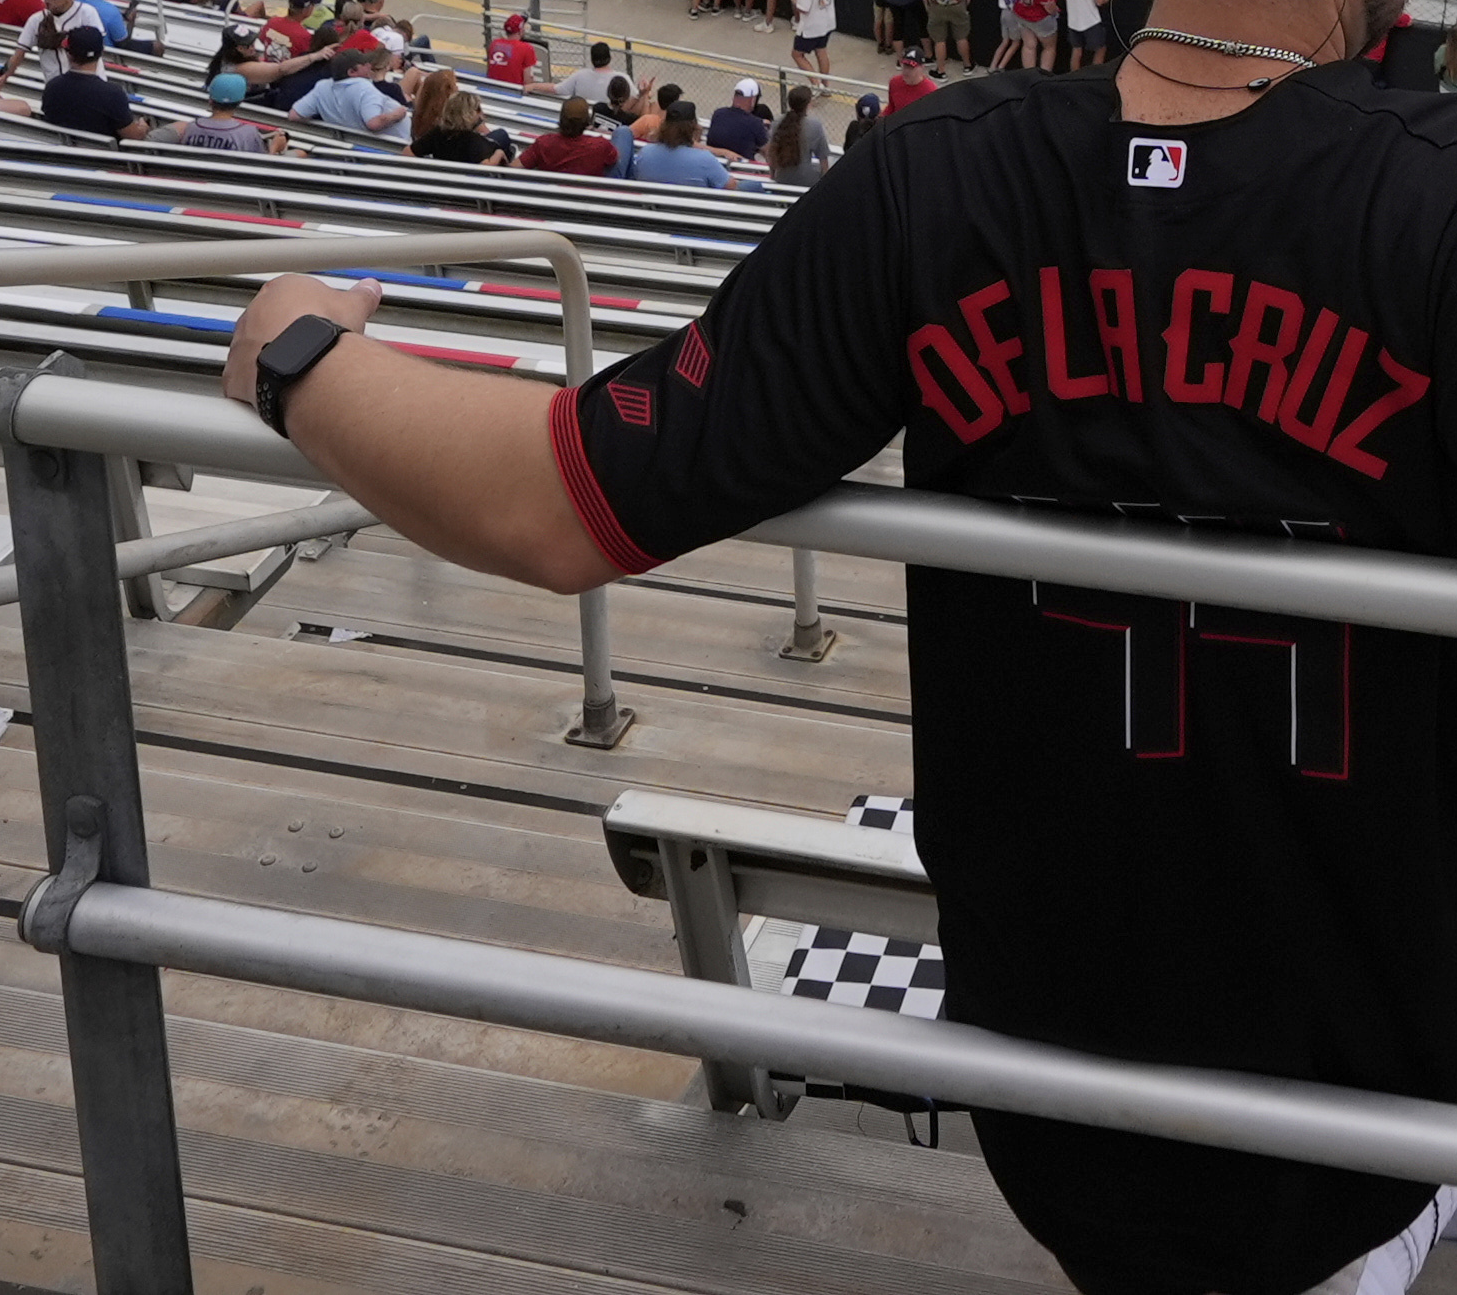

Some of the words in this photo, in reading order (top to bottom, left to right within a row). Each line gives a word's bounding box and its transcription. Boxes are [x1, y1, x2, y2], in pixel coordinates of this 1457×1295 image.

[907, 280, 1030, 444] DE
[1039, 266, 1142, 403] LA
[1161, 268, 1430, 480] CRUZ
